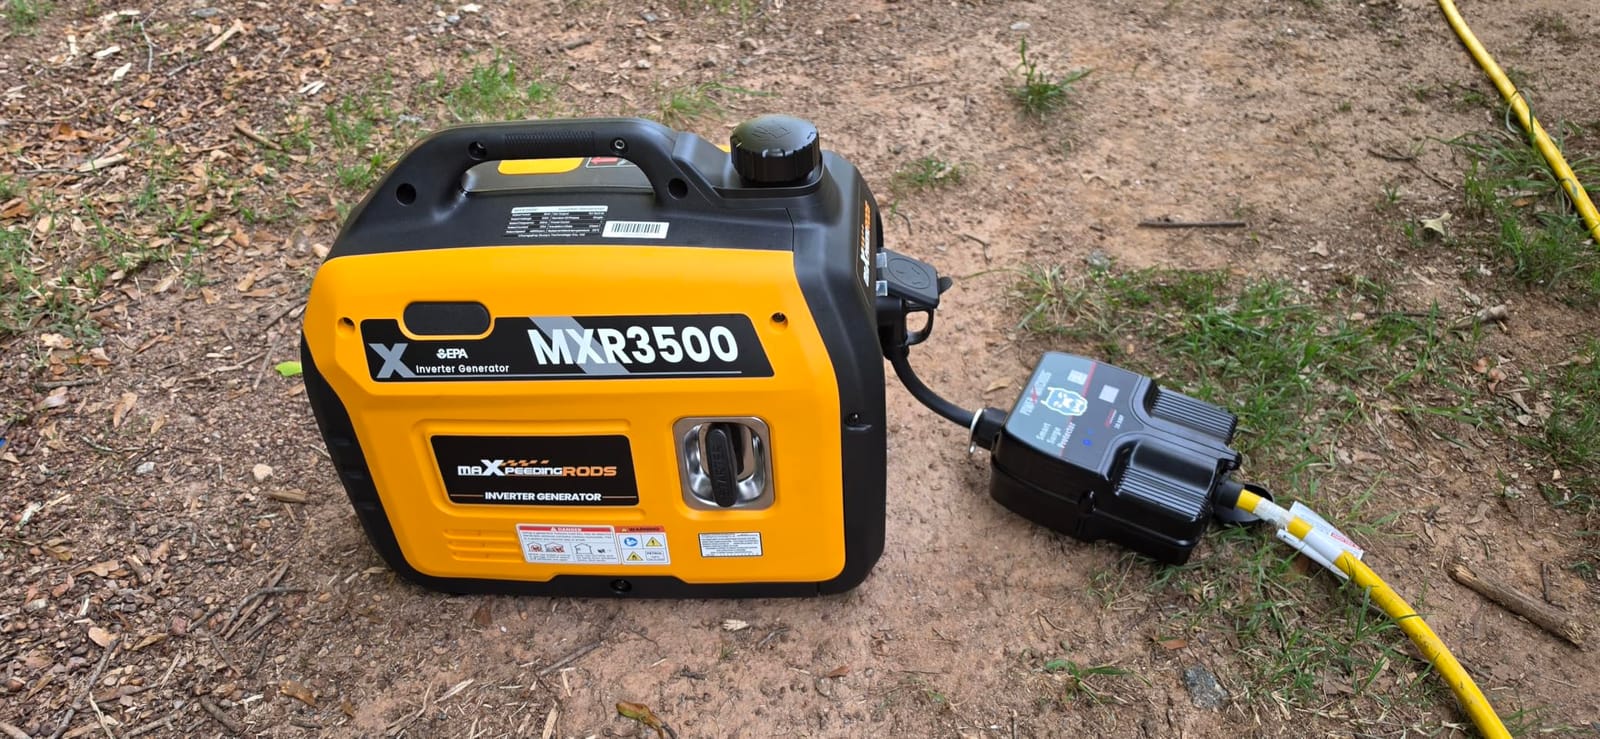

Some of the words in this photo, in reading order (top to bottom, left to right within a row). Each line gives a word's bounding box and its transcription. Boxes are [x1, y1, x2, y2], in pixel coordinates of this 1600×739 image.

[527, 326, 739, 366] MXR3500
[416, 364, 455, 374] Inverter
[458, 364, 510, 374] Generator
[1056, 421, 1076, 449] Protector
[485, 491, 536, 501] INVERTER
[537, 492, 602, 502] GENERATOR
